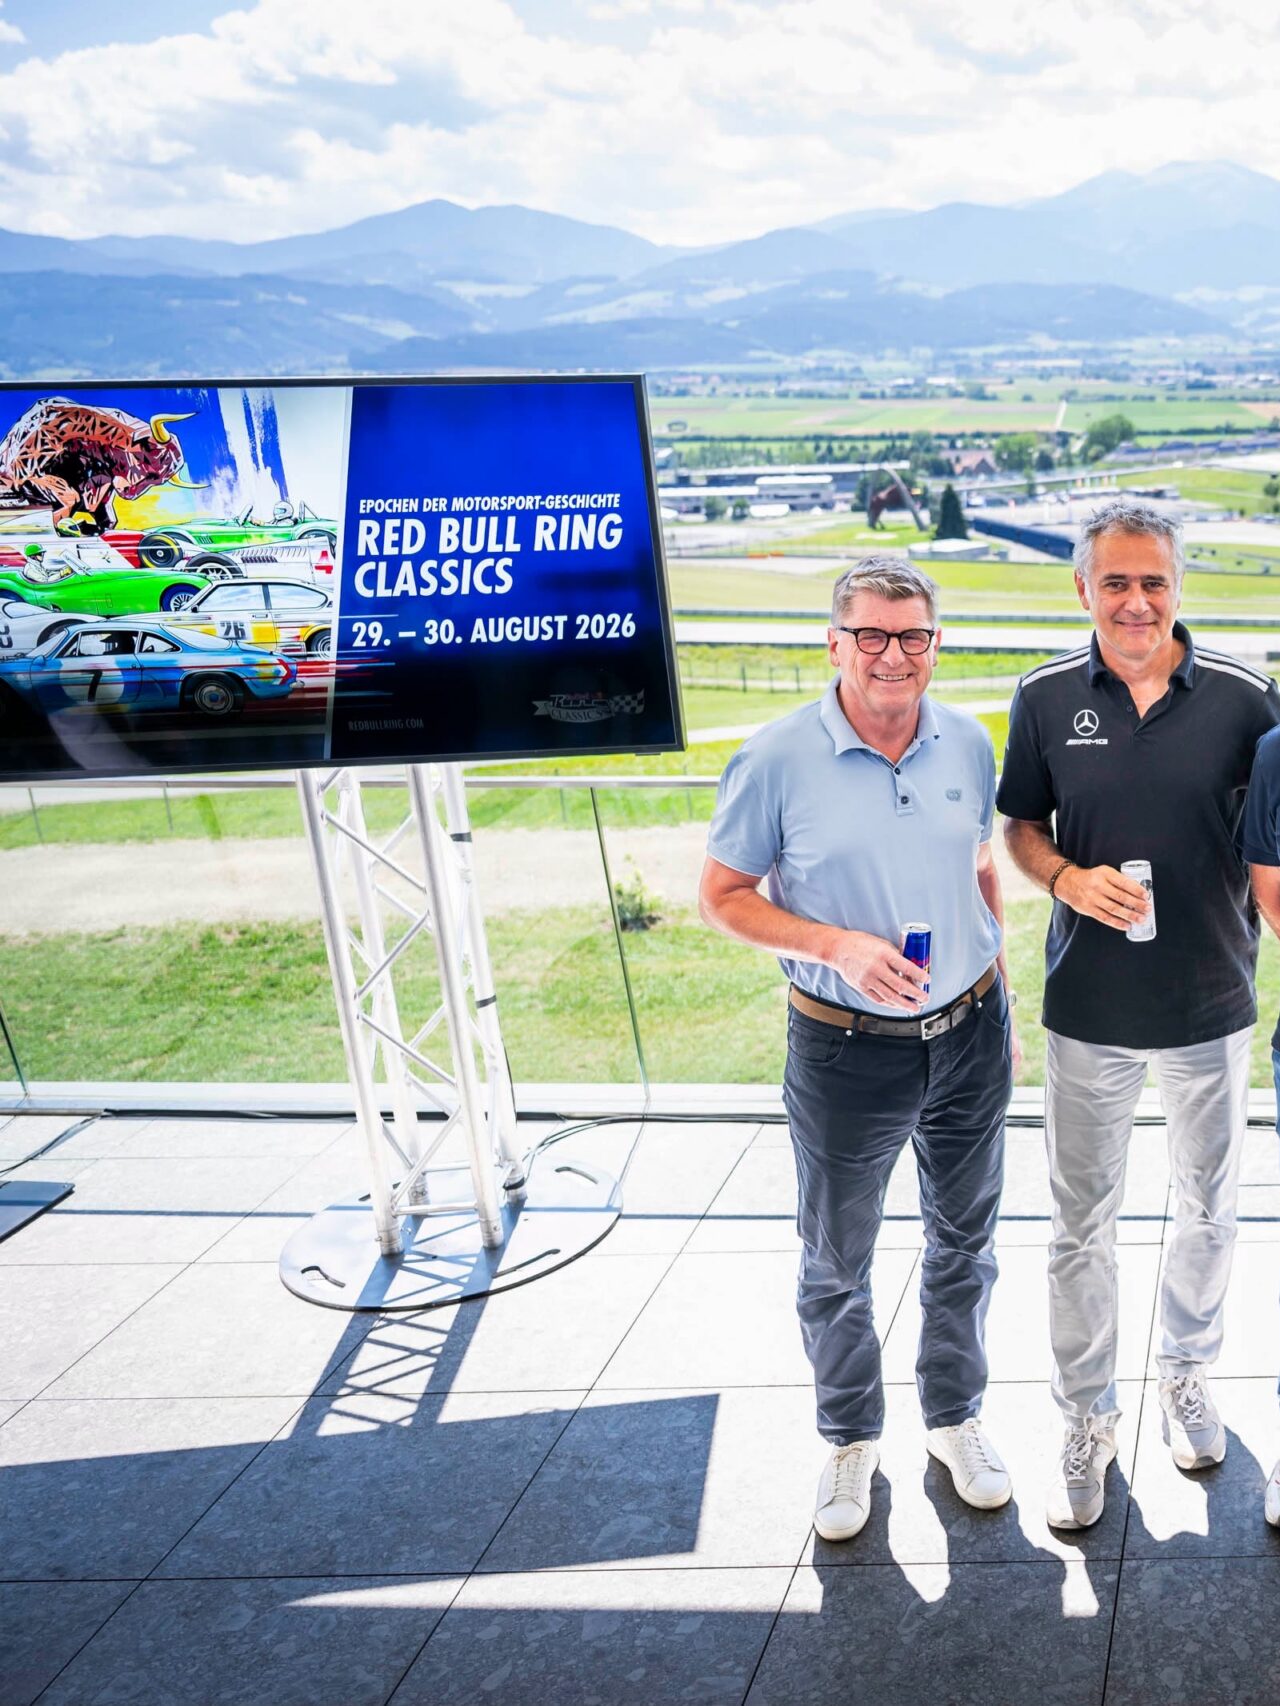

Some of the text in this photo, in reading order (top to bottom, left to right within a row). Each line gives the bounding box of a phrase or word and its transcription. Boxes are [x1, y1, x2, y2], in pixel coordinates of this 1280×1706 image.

[359, 493, 621, 514] EPOCHEN DER MOTORSPORT-GESCHICHTE
[357, 512, 624, 556] RED BULL RING
[354, 557, 514, 598] CLASSICS
[352, 621, 392, 648] 29.
[423, 619, 463, 645] 30.
[470, 615, 568, 643] AUGUST
[575, 612, 637, 640] 2026
[80, 668, 102, 702] 7
